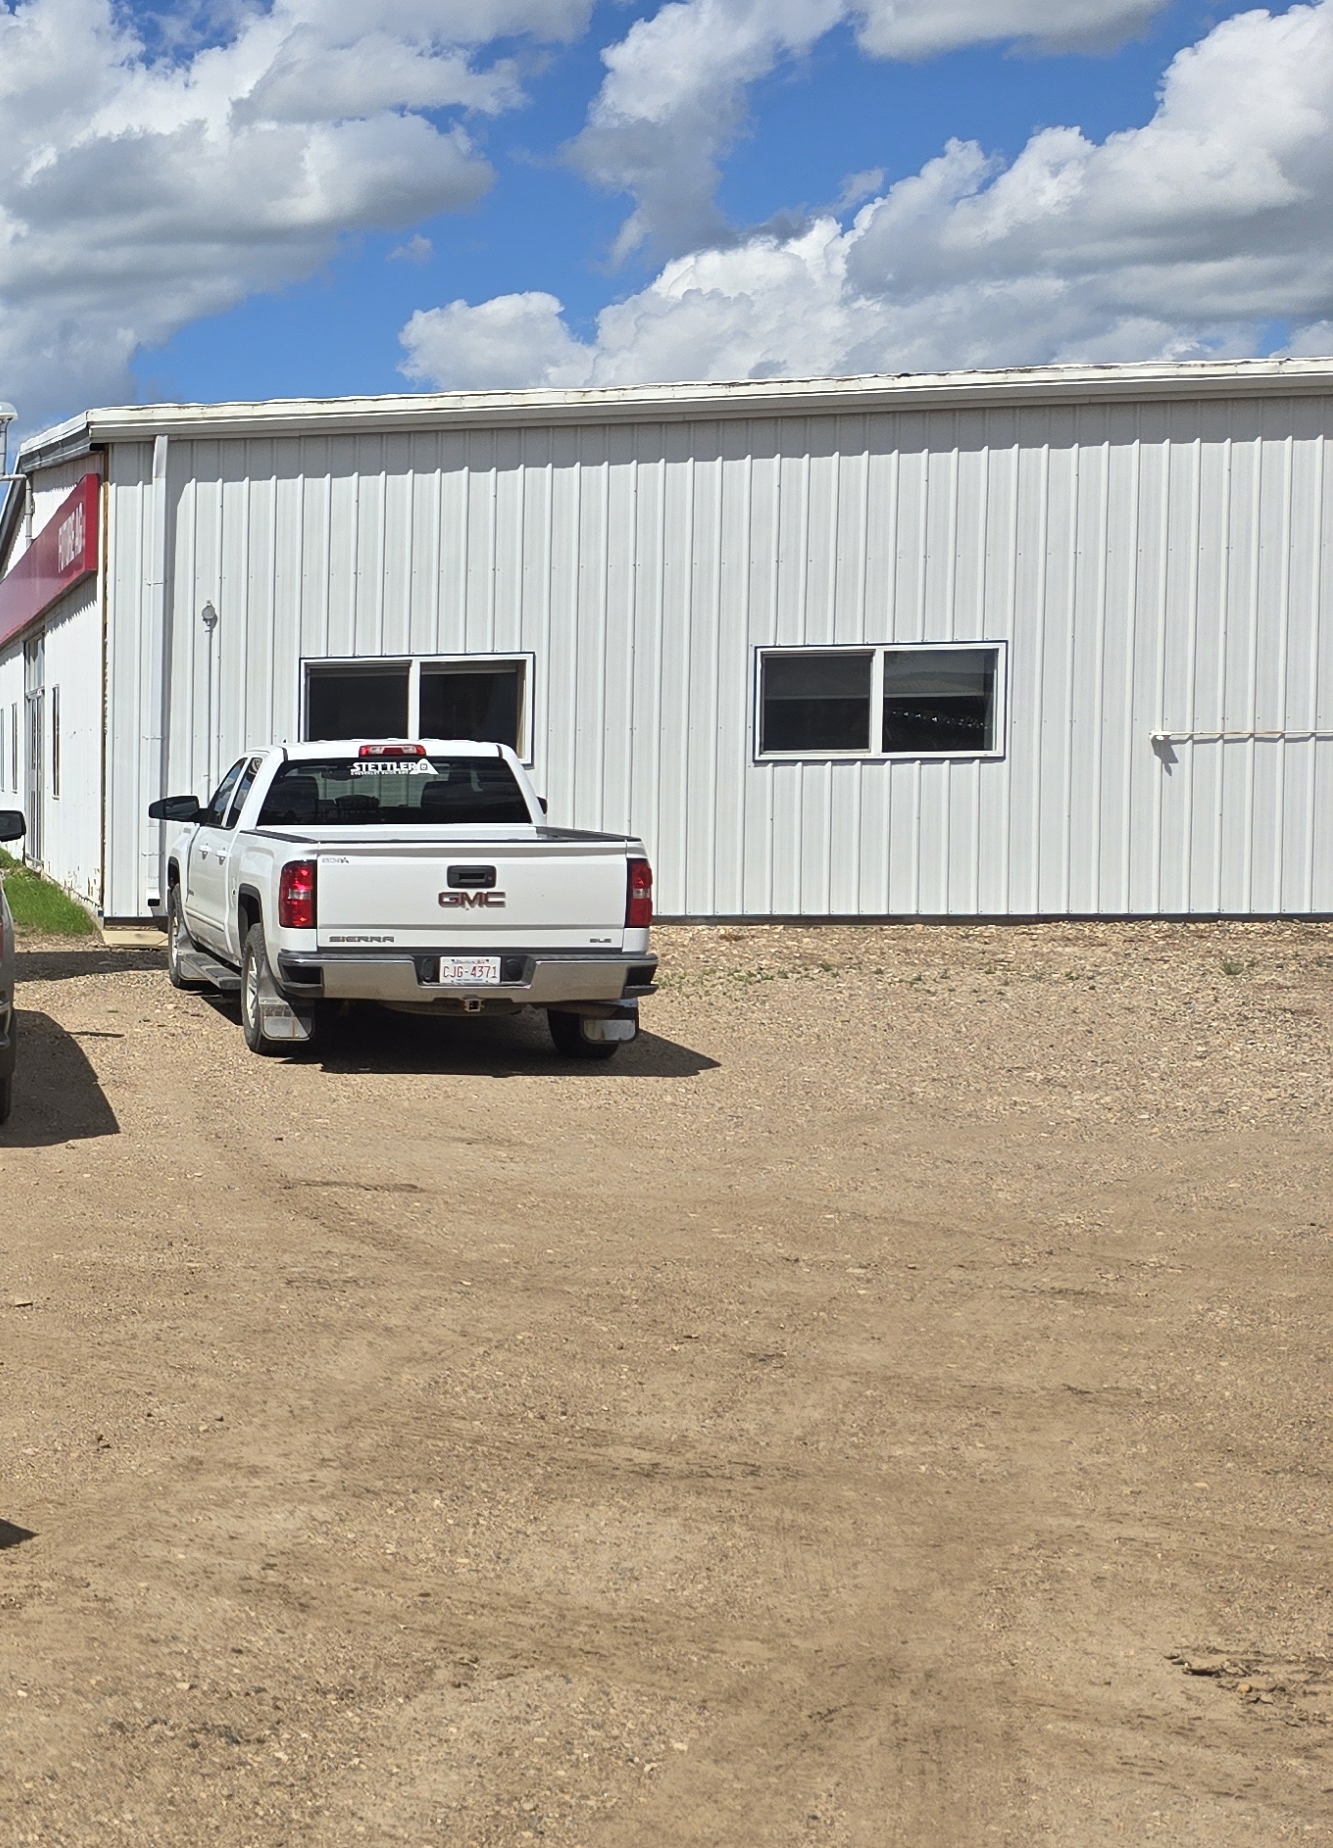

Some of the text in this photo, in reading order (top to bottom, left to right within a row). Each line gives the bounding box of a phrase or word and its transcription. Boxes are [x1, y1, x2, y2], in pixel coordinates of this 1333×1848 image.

[353, 761, 417, 772] STETTLER
[438, 891, 506, 909] GMC
[328, 935, 395, 943] SIERRA
[443, 965, 498, 979] CJG-4371
